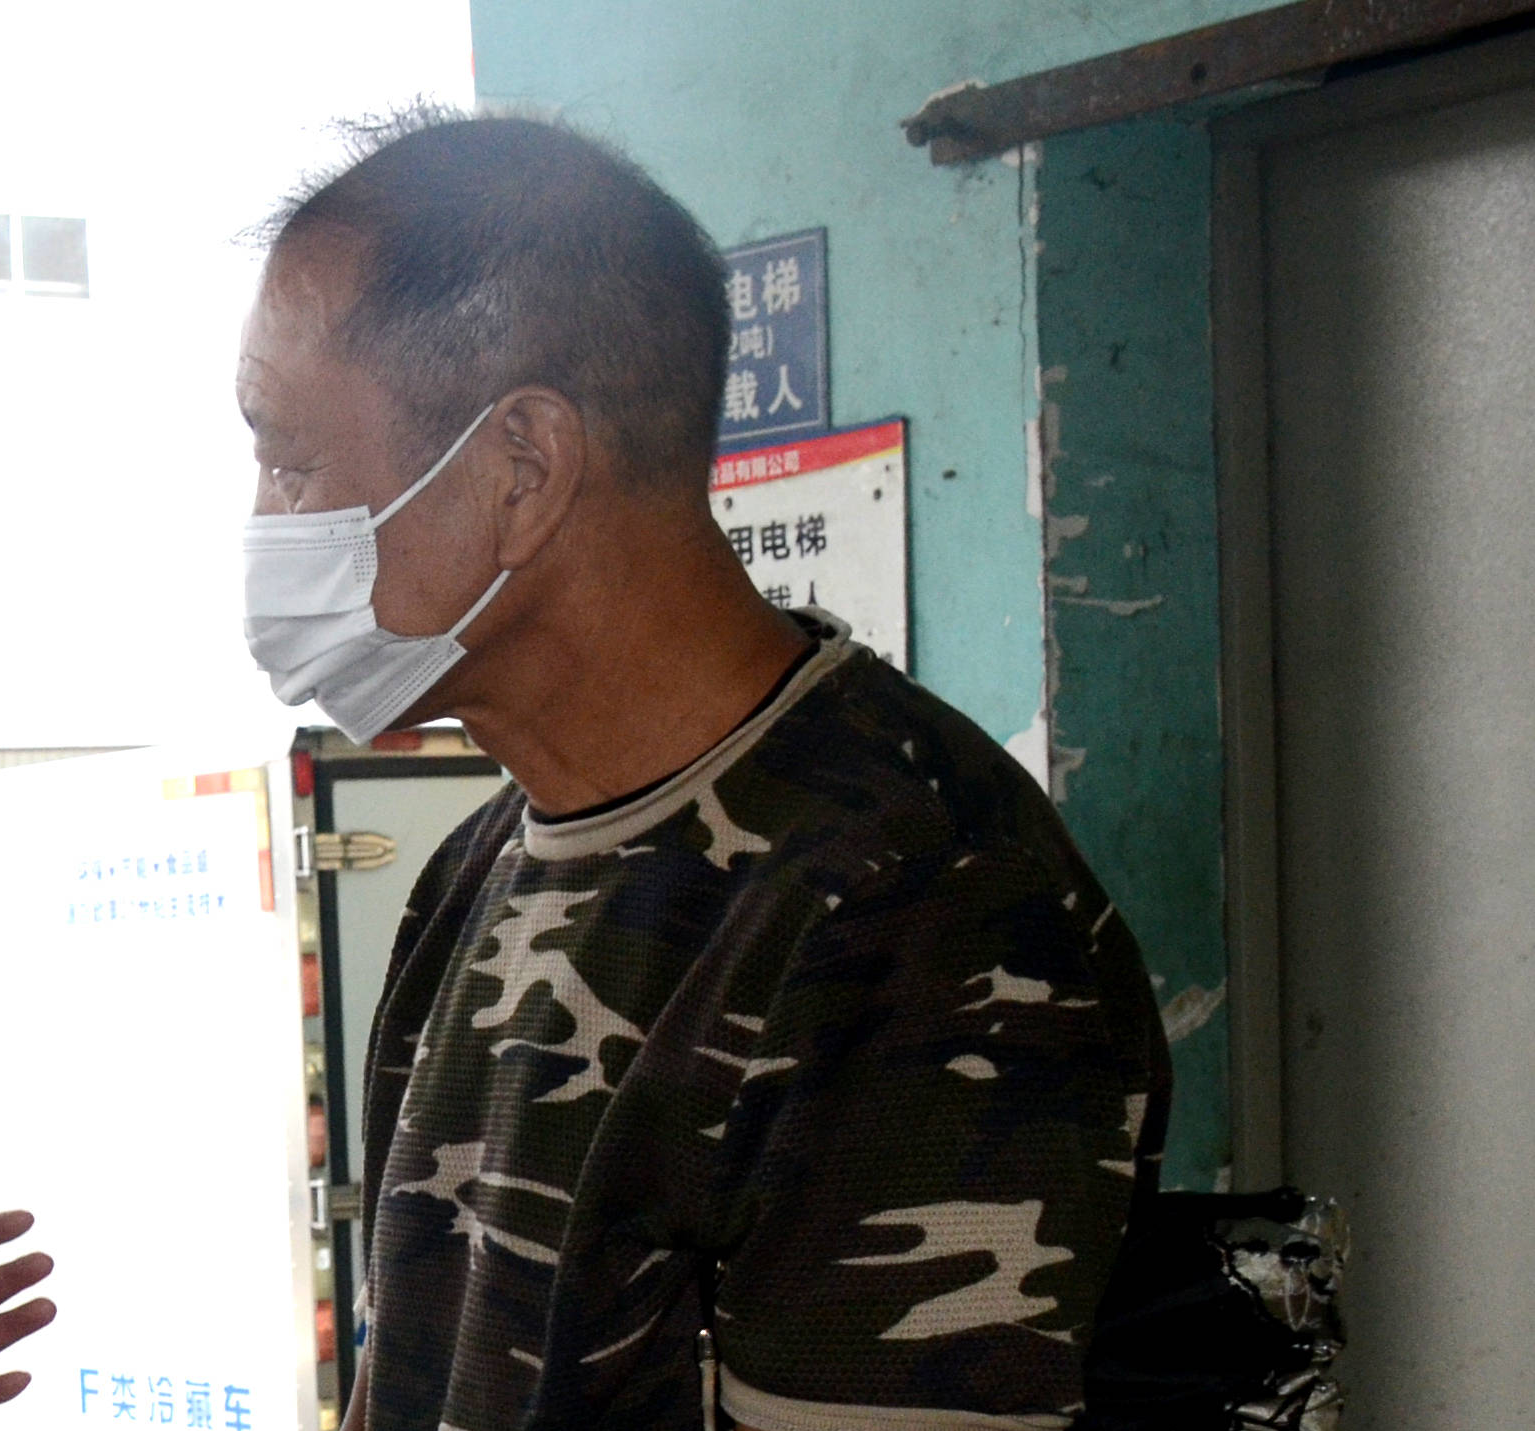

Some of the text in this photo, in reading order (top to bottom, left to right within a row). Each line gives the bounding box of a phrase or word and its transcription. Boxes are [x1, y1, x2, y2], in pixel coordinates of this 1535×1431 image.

[724, 256, 802, 320] 电梯
[724, 364, 803, 422] 载人
[726, 514, 828, 565] 用电梯
